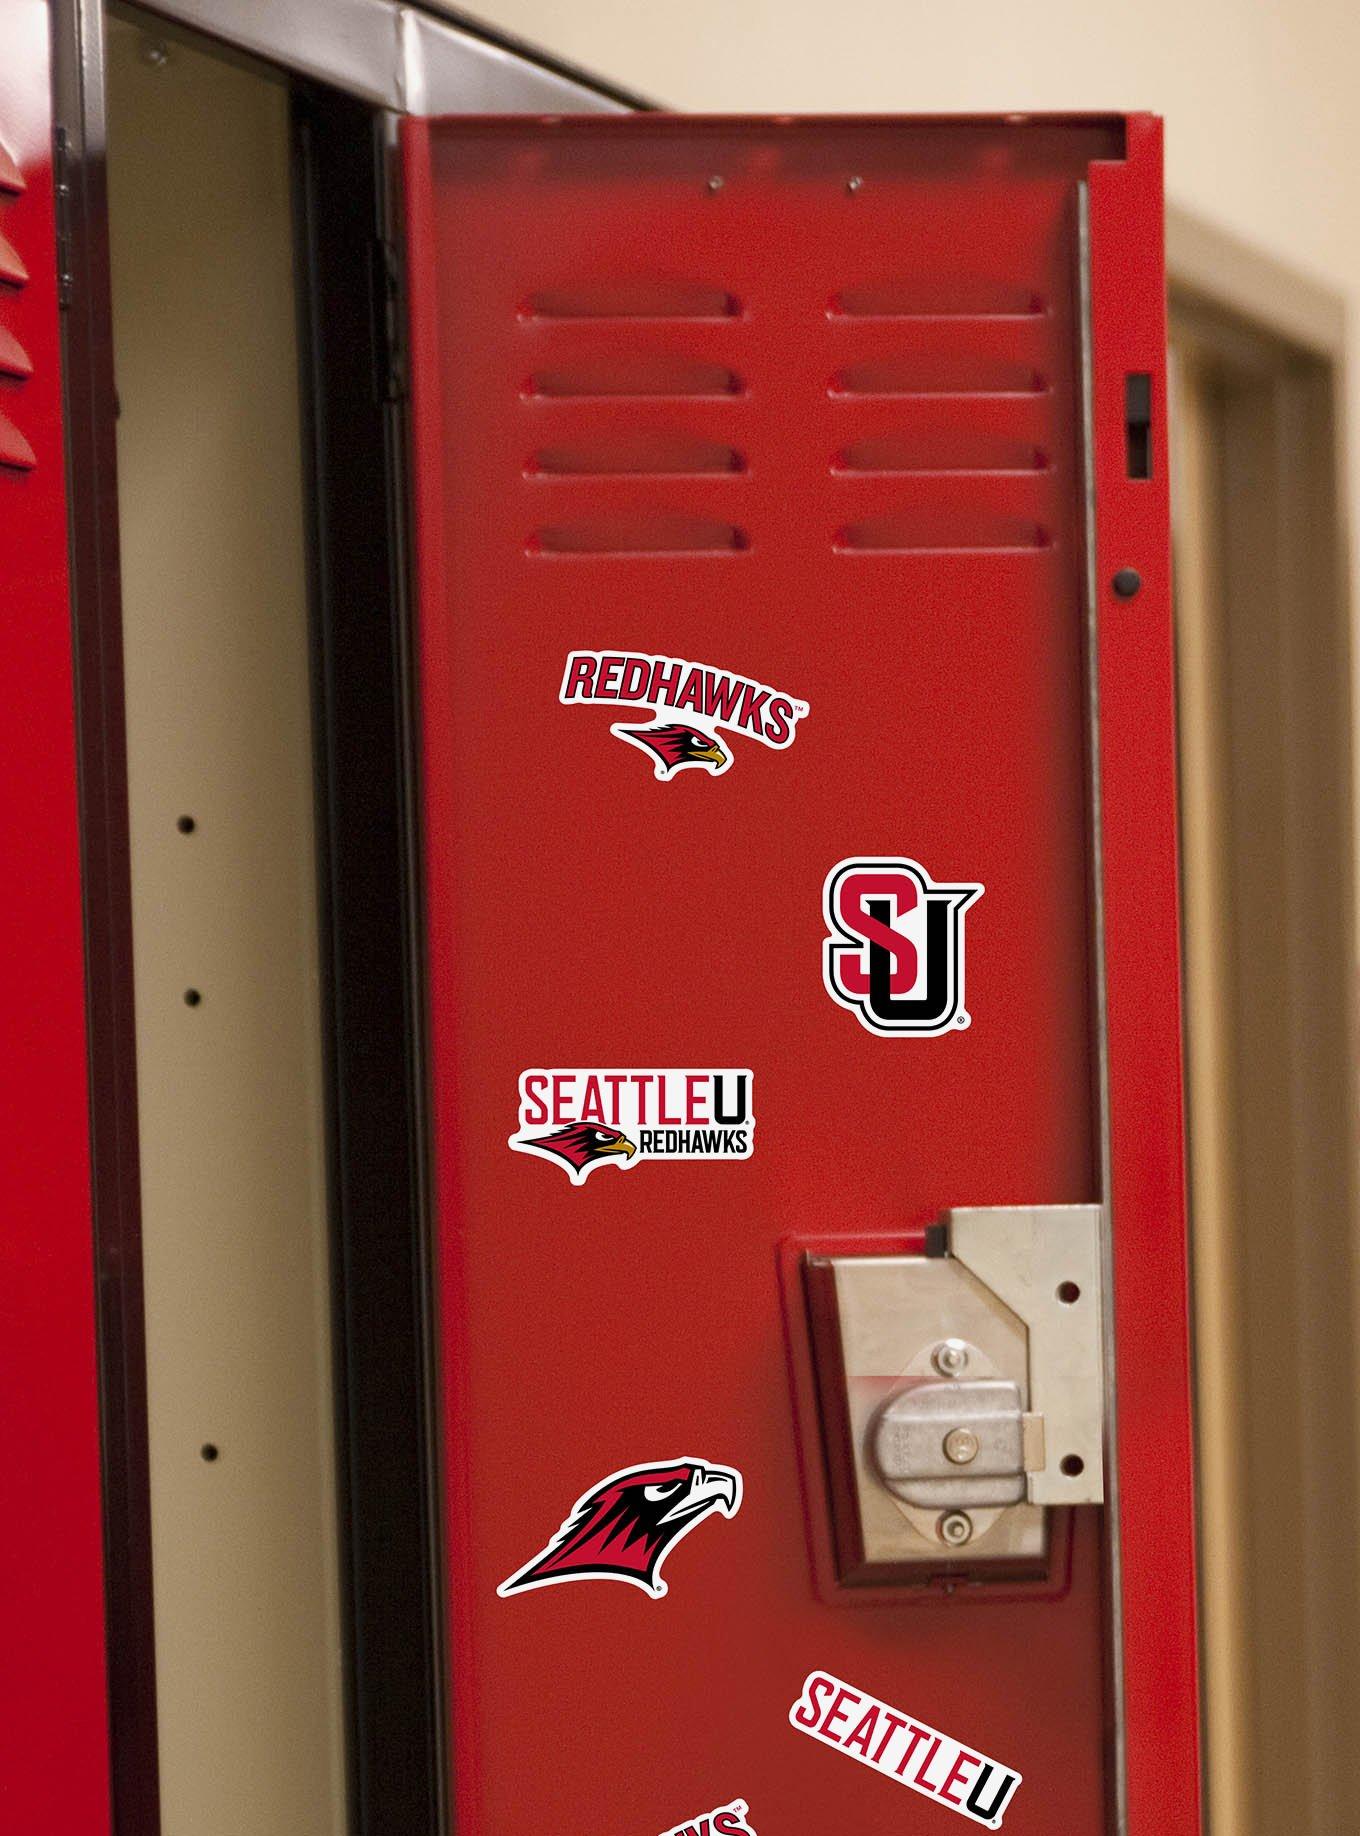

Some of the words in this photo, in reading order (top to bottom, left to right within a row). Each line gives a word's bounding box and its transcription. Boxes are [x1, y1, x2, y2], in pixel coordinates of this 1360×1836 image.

[564, 656, 794, 744] REDHAWKS
[839, 873, 953, 1021] SU
[639, 1129, 748, 1154] REDHAWKS
